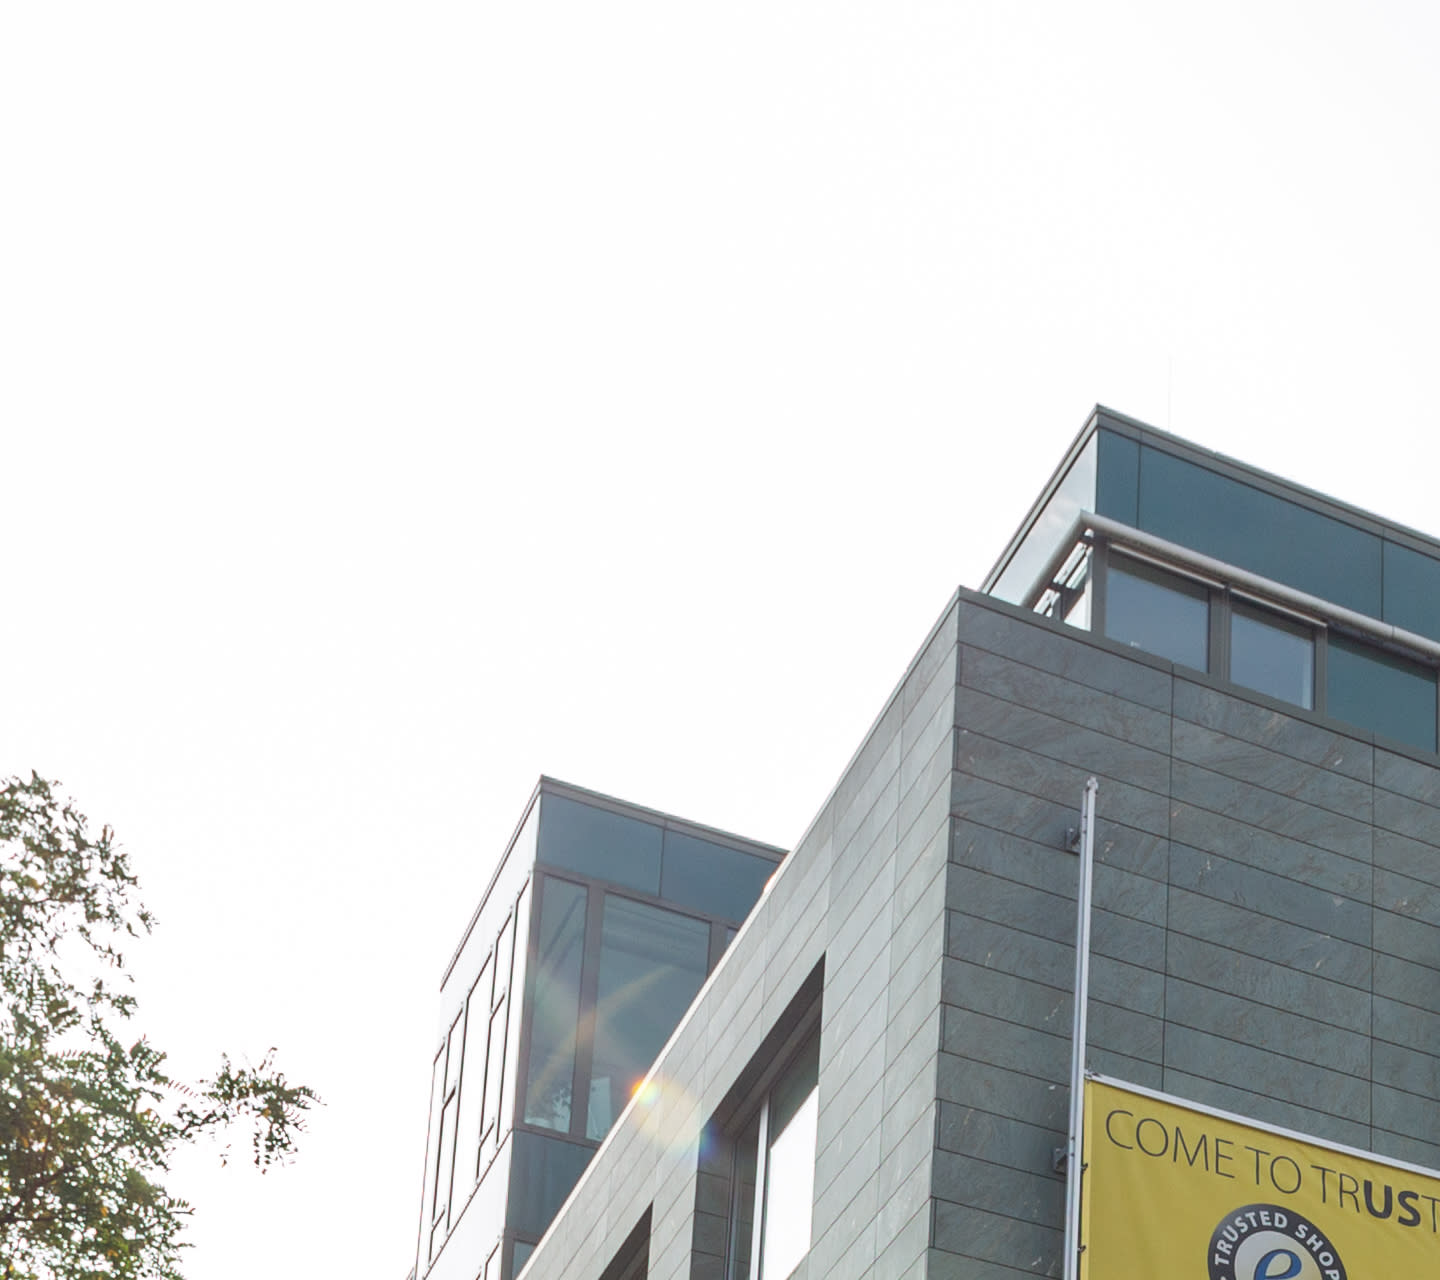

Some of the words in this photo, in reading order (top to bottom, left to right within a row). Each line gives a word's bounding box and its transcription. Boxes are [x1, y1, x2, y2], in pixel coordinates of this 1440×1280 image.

[1106, 1109, 1235, 1180] COME
[1244, 1145, 1302, 1195] TO
[1214, 1210, 1288, 1267] TRUSTED
